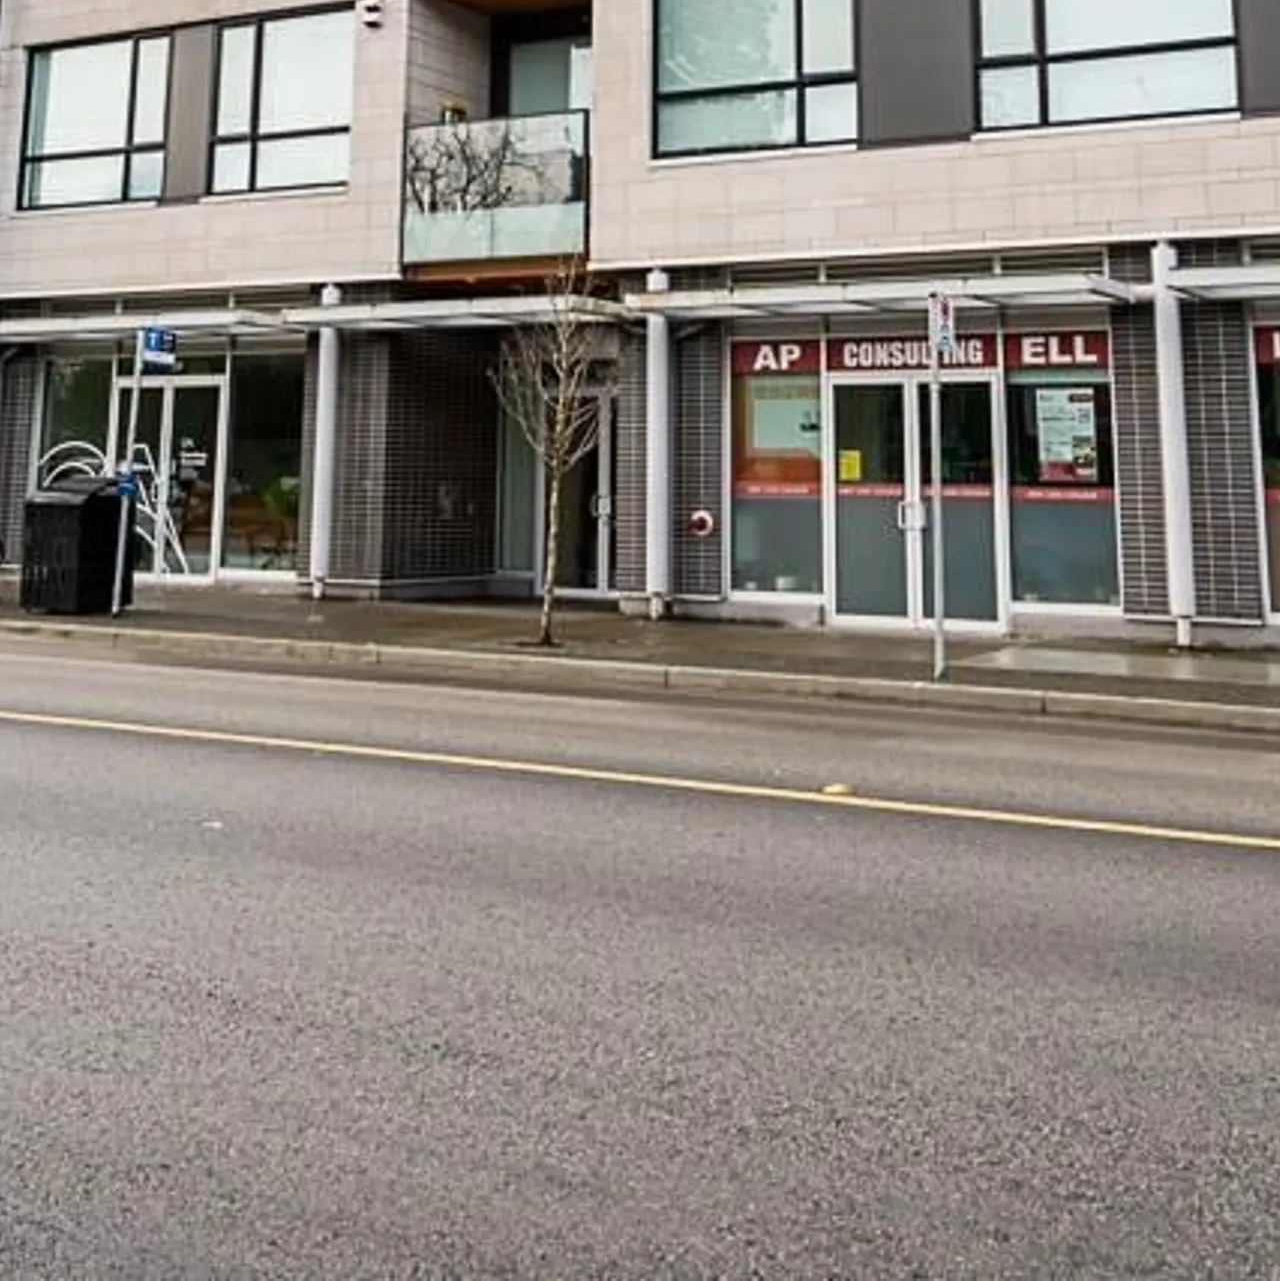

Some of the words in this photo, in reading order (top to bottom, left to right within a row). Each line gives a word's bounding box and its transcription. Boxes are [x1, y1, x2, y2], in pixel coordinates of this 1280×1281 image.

[753, 344, 803, 371] AP
[842, 338, 984, 369] CONSULING
[1020, 334, 1099, 366] ELL
